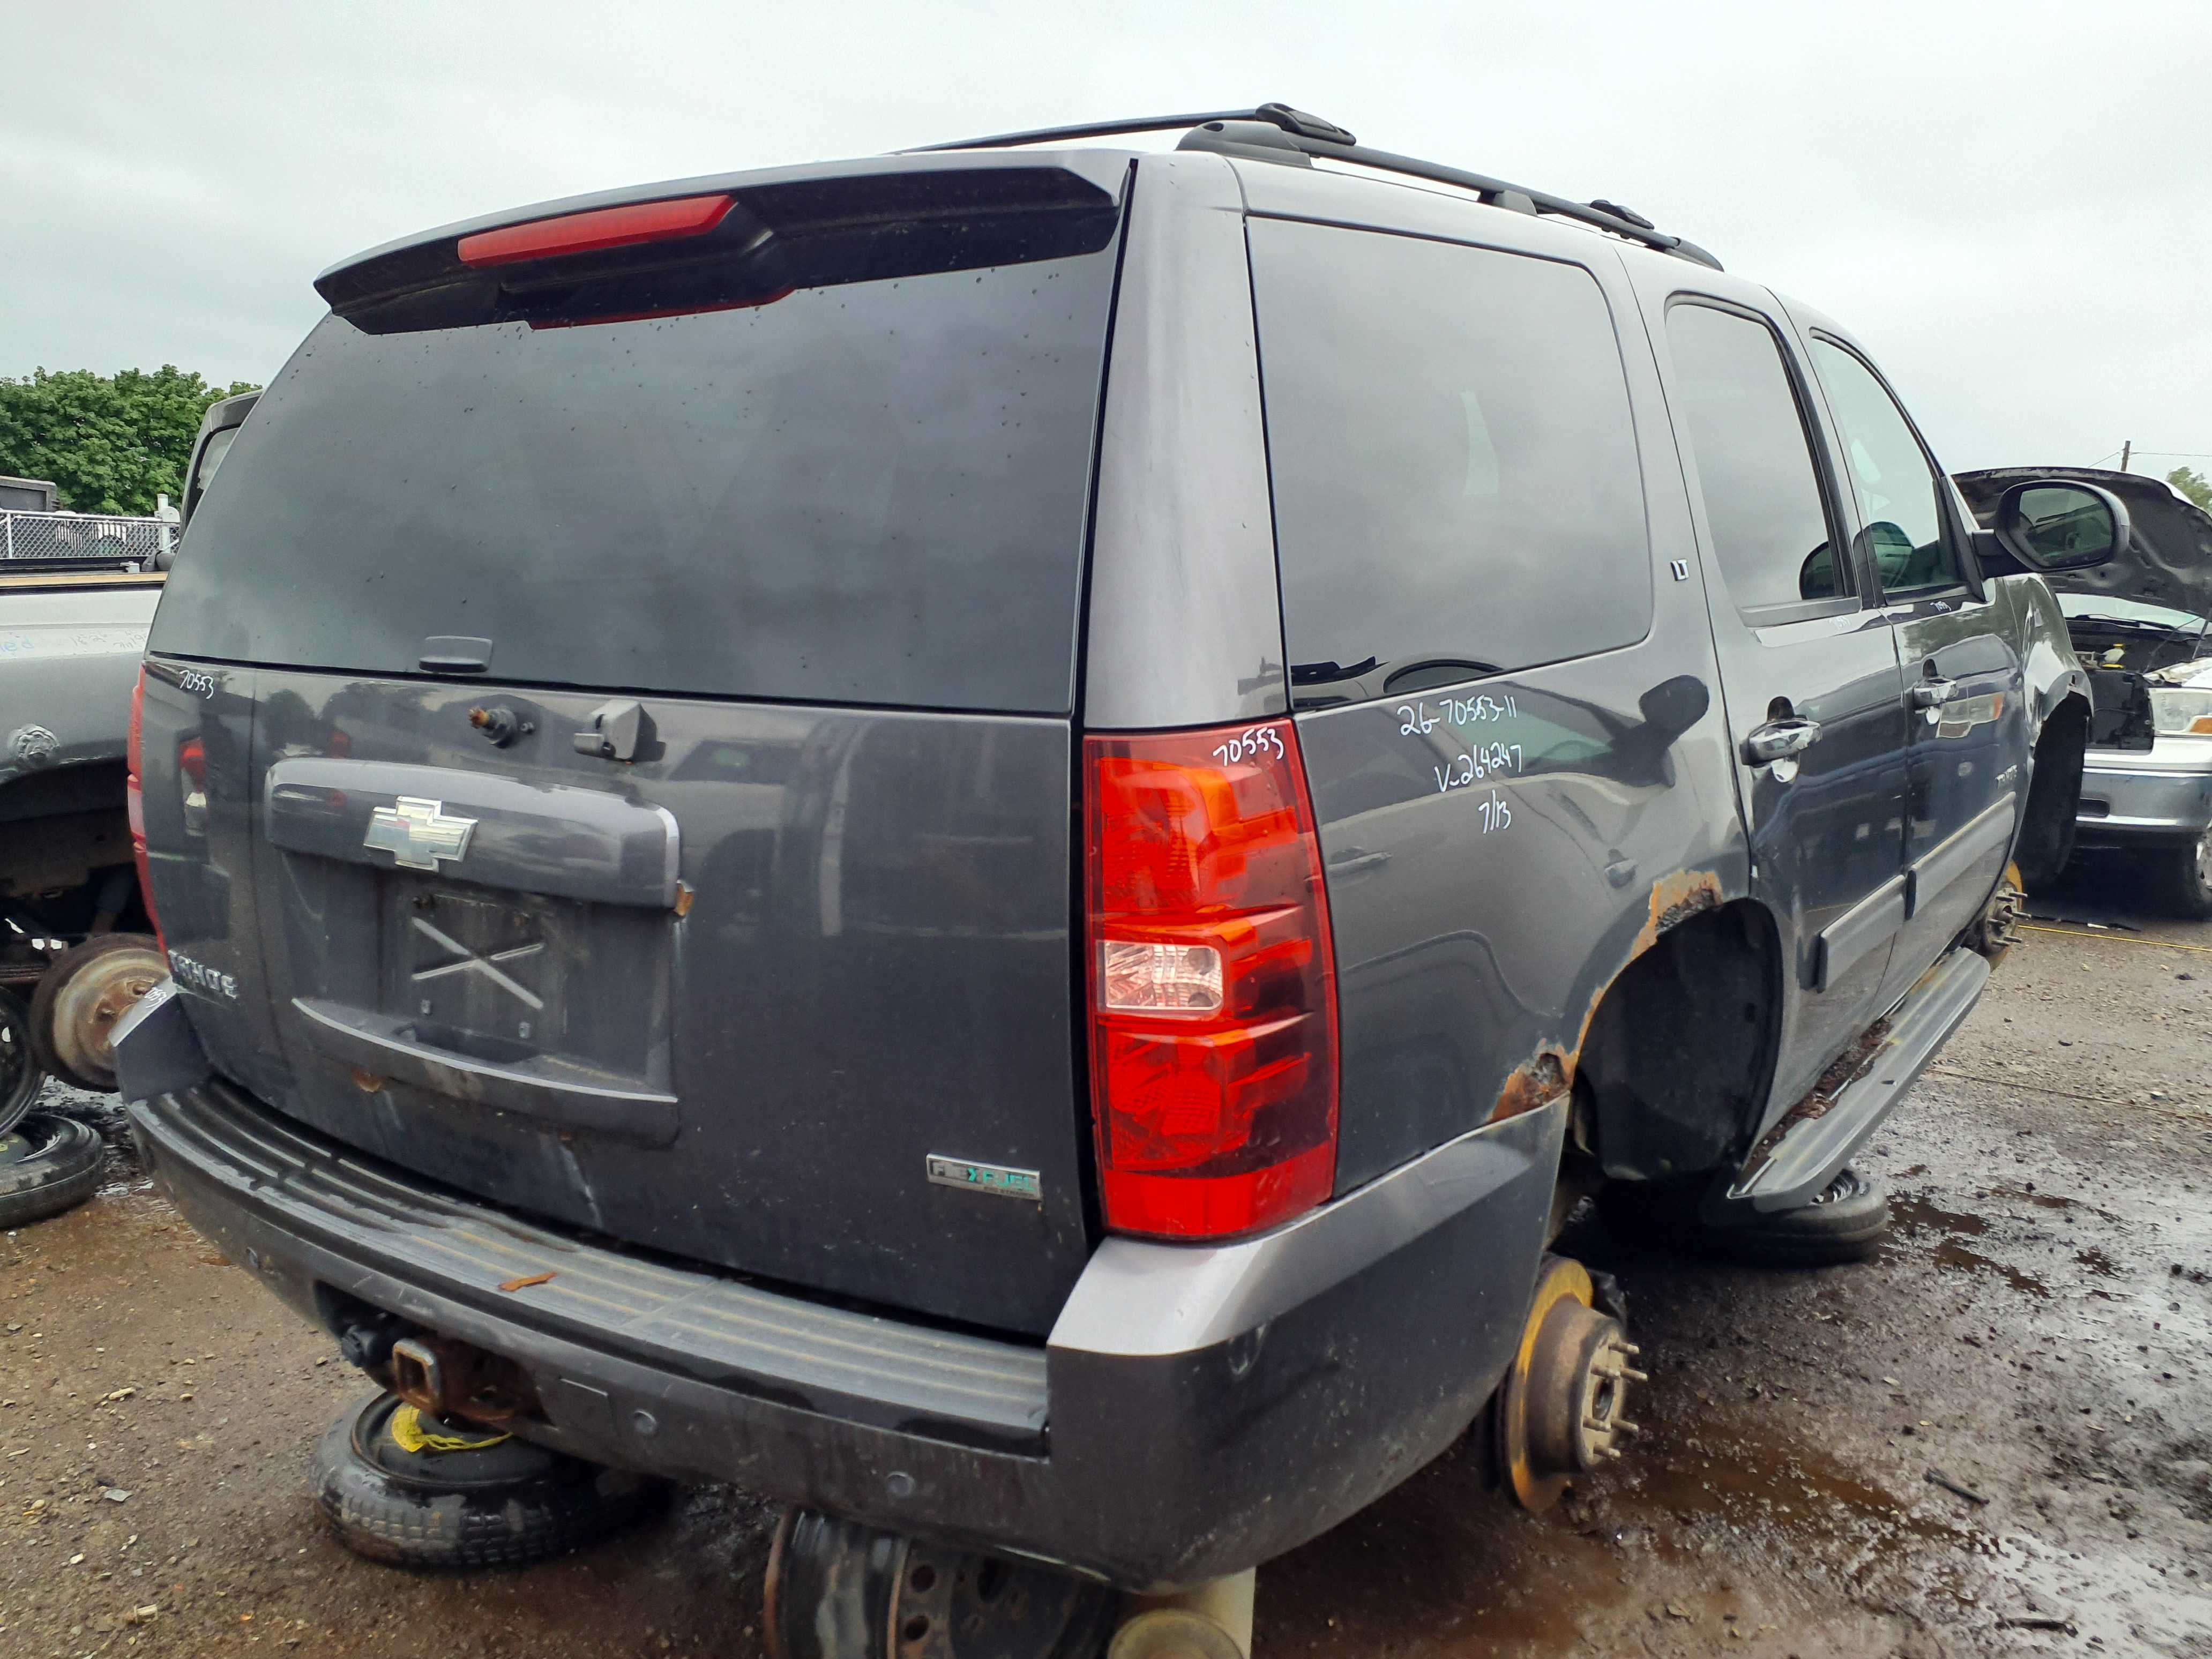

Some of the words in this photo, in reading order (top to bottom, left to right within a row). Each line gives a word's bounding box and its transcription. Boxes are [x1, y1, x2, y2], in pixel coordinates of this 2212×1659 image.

[1670, 559, 1690, 581] LT
[179, 669, 214, 699] 70553
[1212, 726, 1284, 766] 70553
[1434, 742, 1522, 793] V-264247
